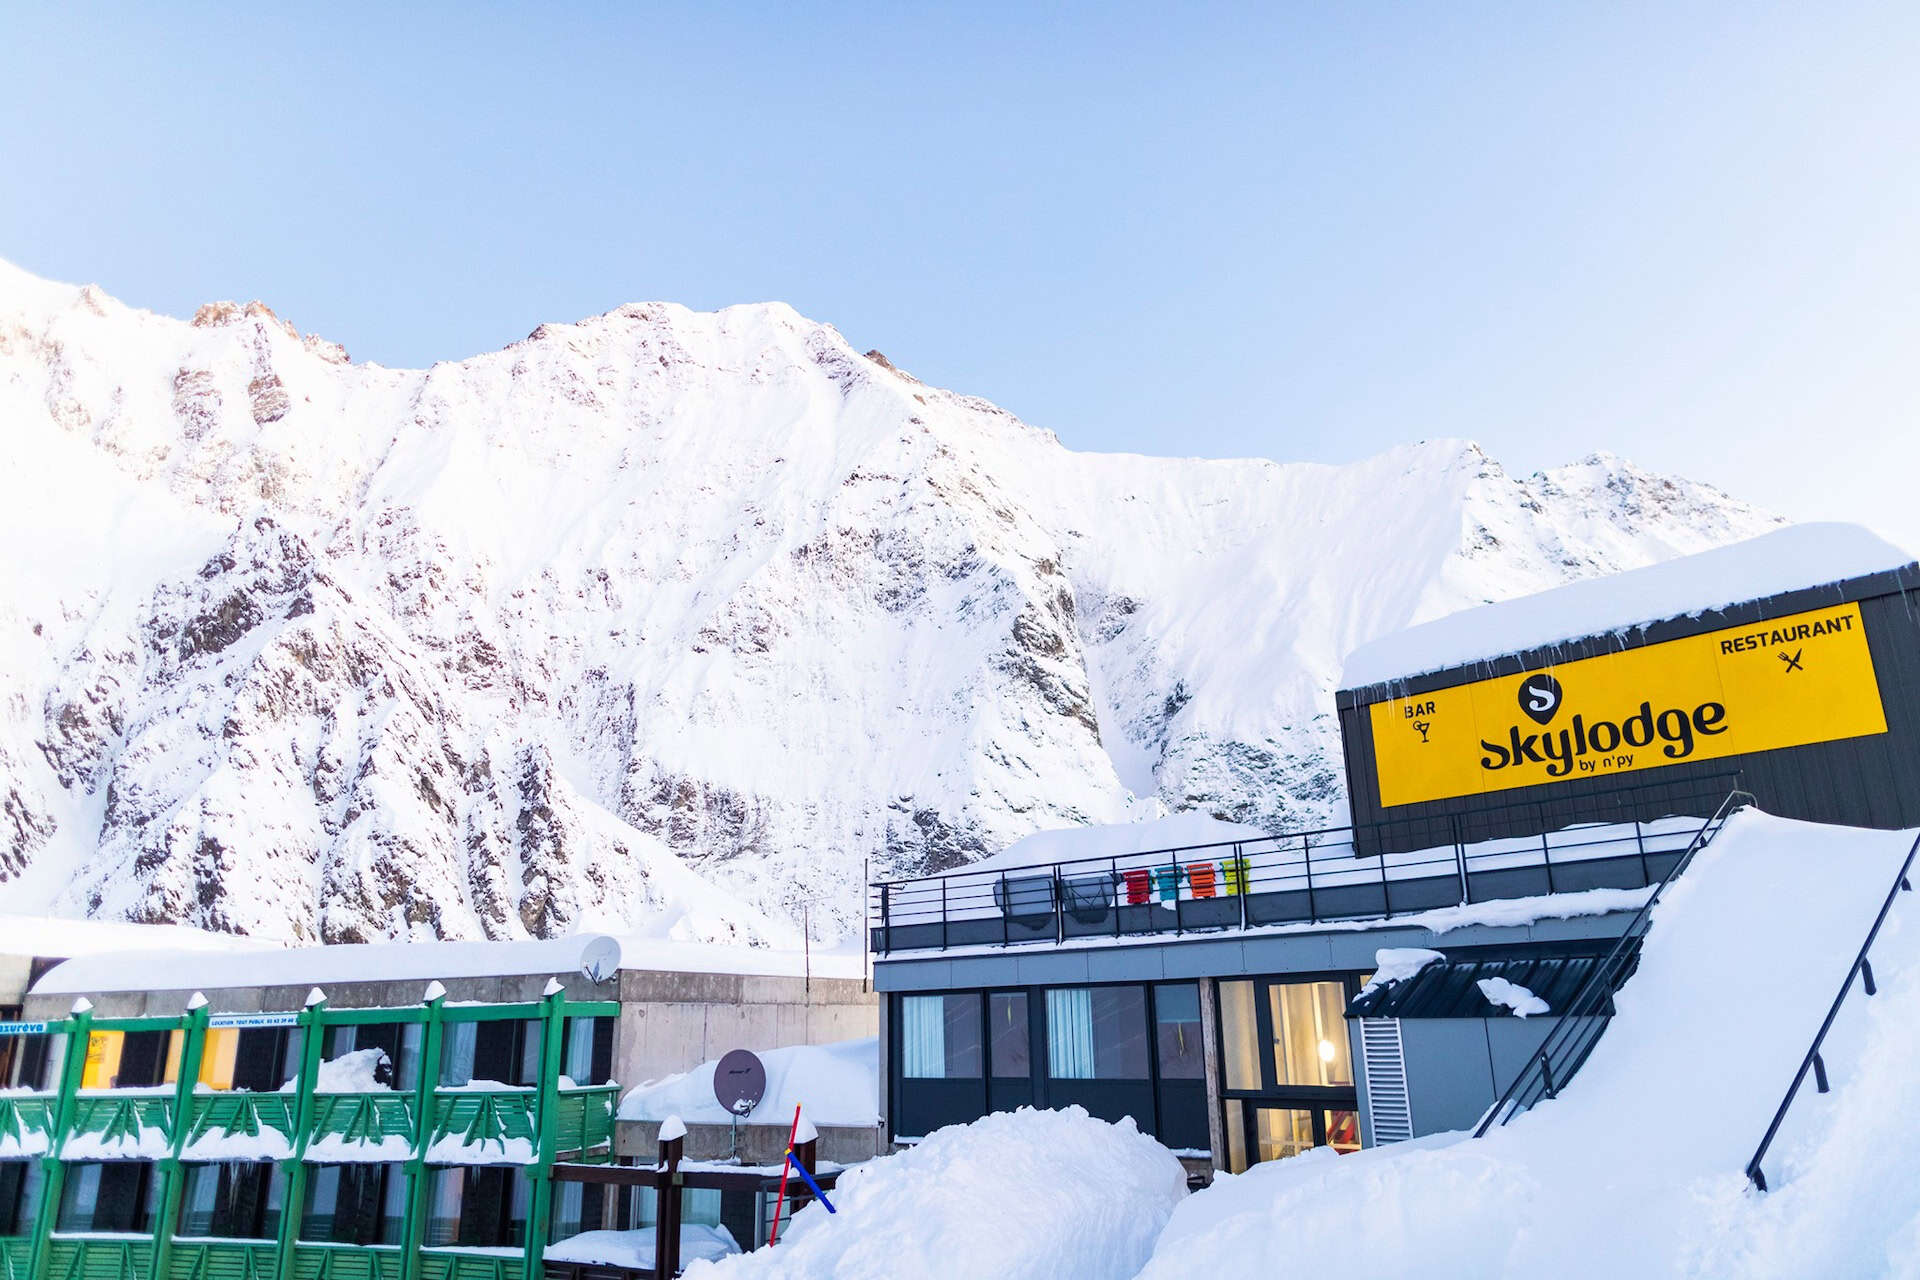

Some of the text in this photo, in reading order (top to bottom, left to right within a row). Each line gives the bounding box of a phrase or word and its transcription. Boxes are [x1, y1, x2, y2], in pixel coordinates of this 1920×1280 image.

[1720, 615, 1853, 655] RESTAURANT
[1404, 701, 1436, 719] BAR
[1579, 754, 1634, 772] by n'py
